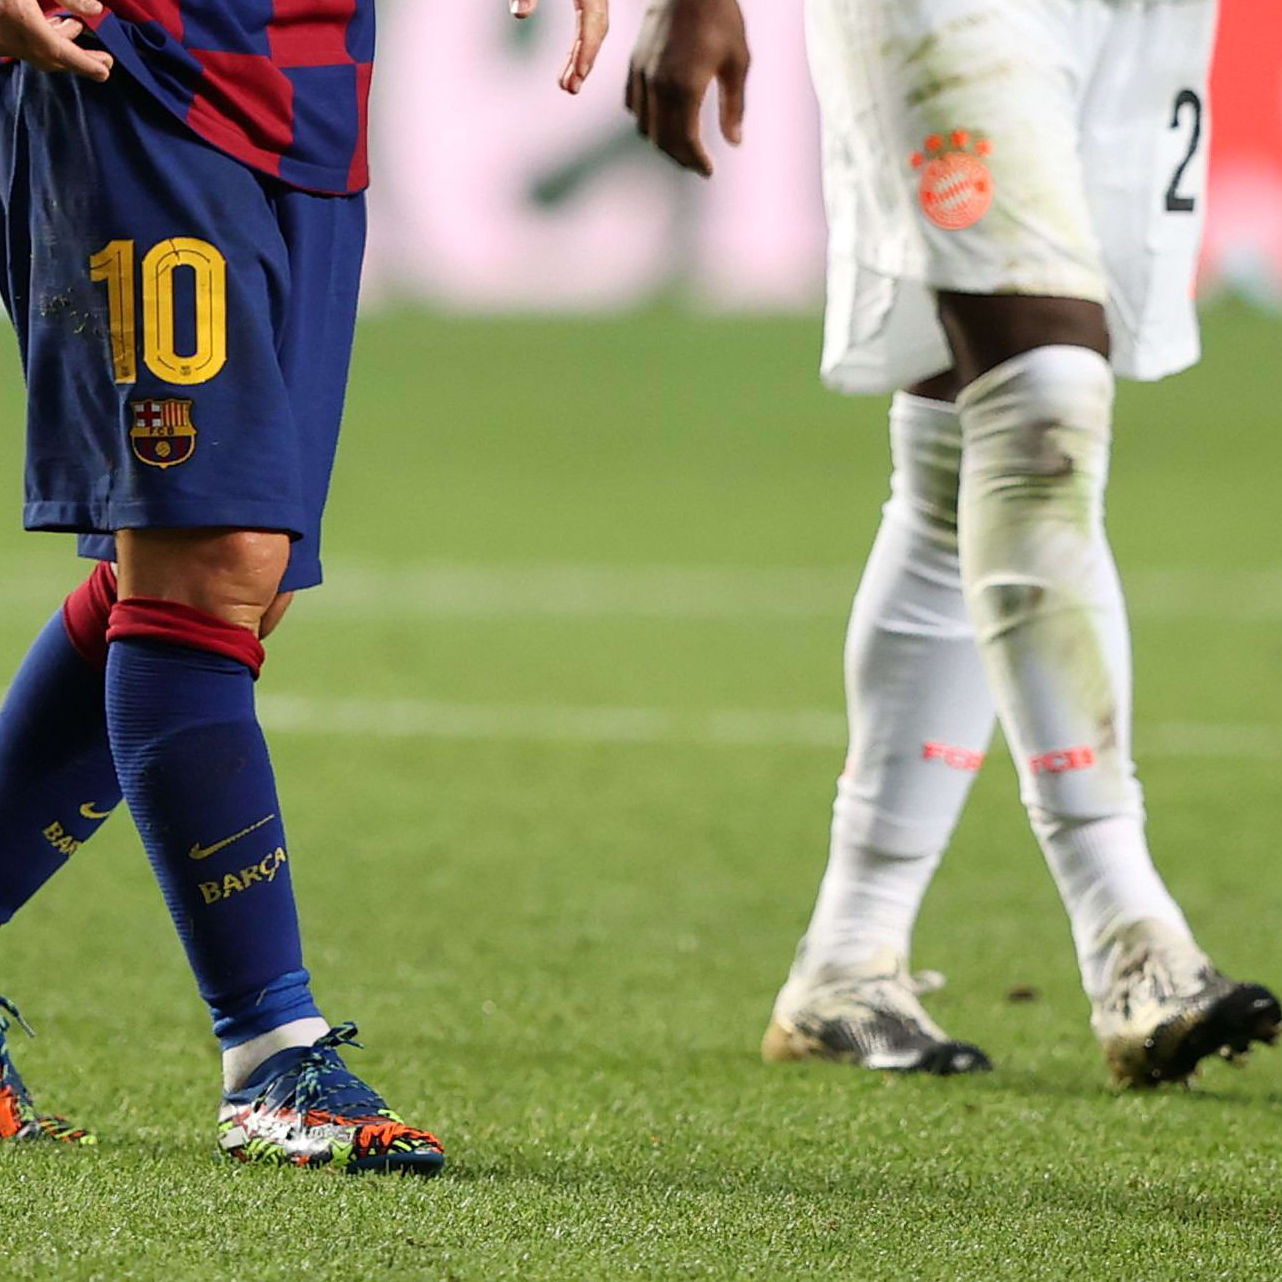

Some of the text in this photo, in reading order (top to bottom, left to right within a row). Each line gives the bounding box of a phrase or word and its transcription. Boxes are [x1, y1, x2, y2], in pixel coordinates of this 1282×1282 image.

[1165, 89, 1201, 212] 2
[89, 236, 228, 385] 10
[198, 846, 287, 904] BARÇA
